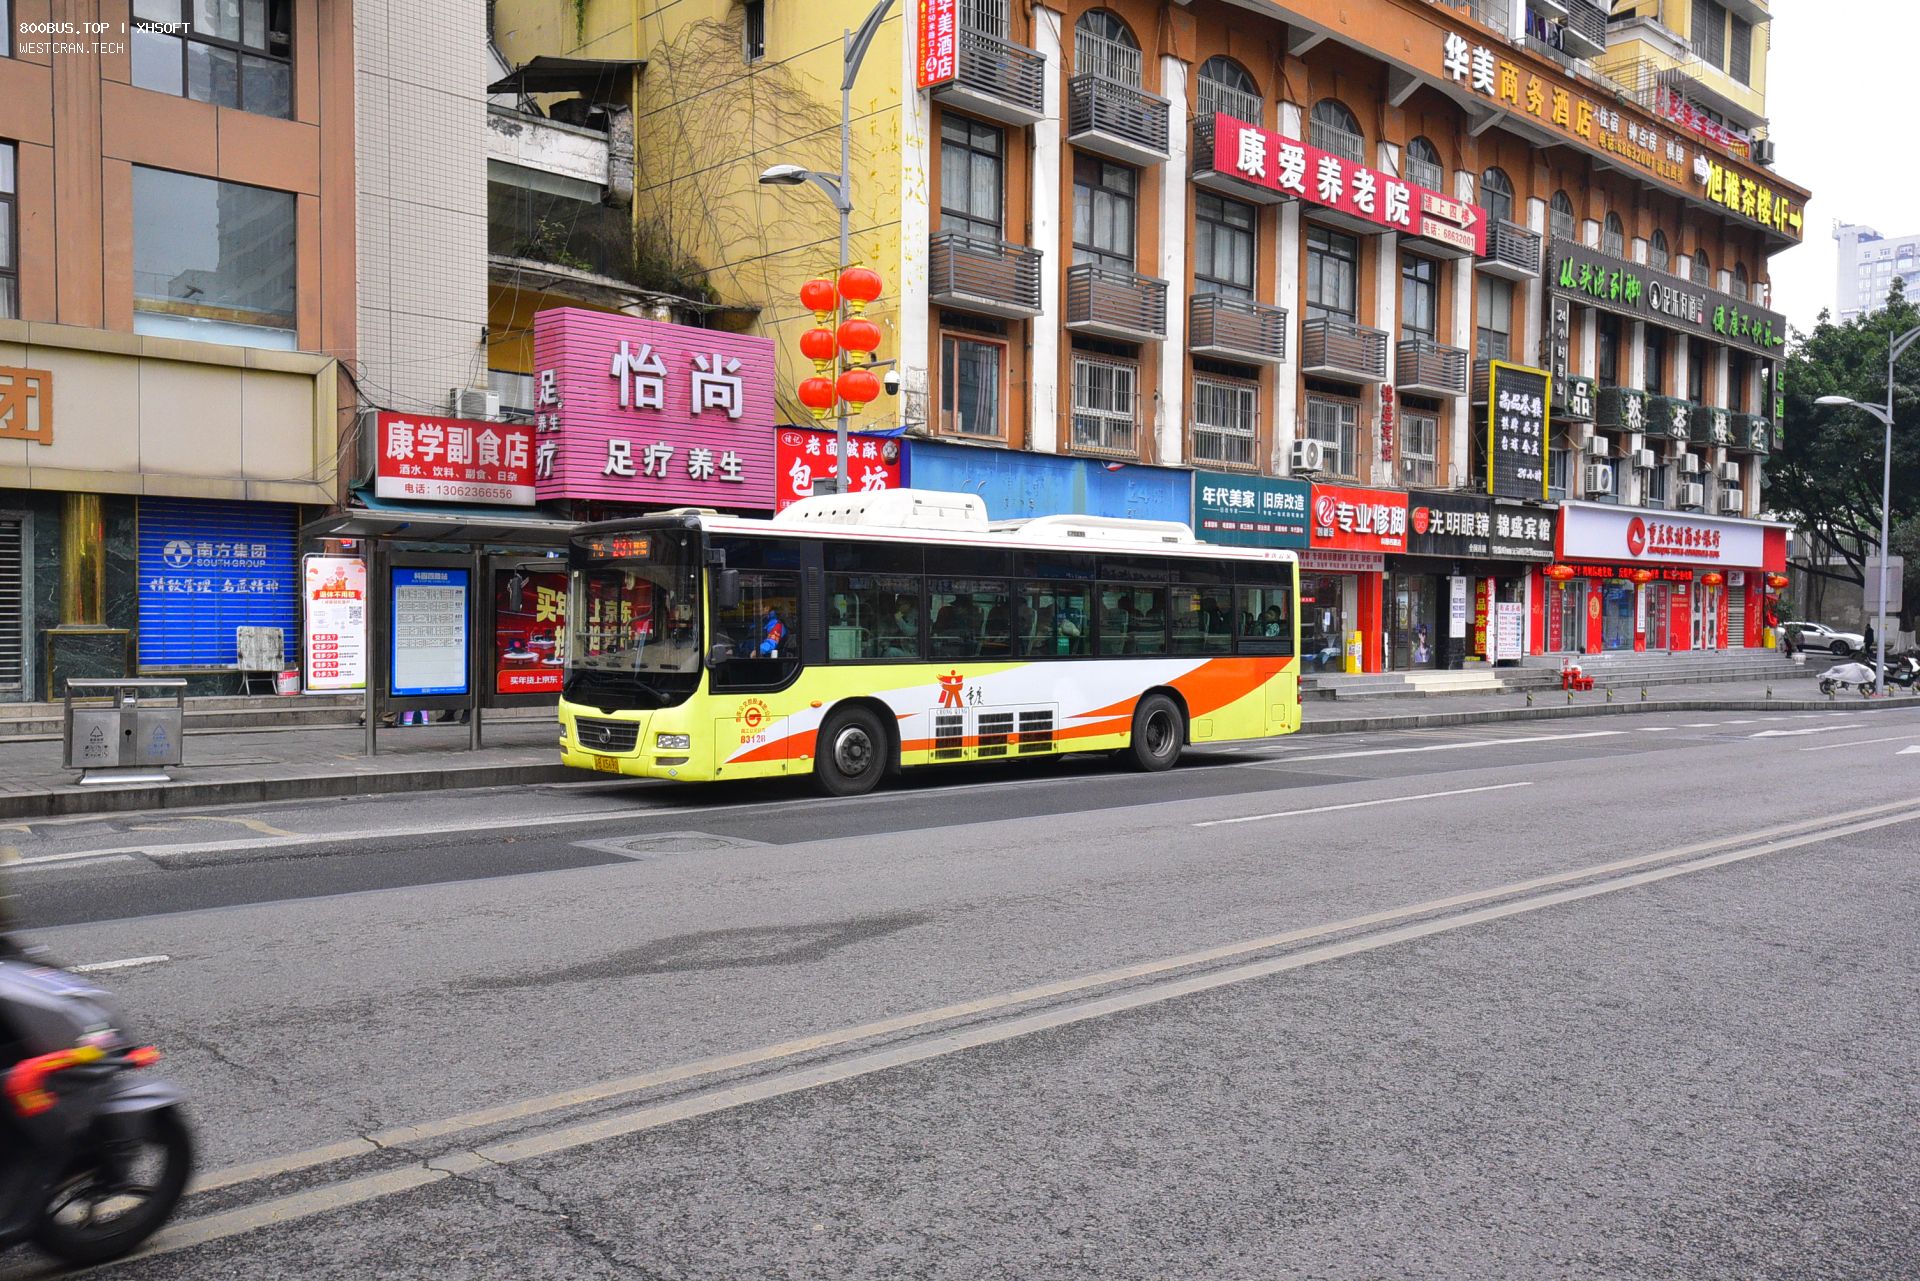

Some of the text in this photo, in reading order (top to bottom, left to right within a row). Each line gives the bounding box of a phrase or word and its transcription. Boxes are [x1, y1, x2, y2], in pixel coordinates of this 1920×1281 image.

[1444, 31, 1495, 96] 华美
[1499, 60, 1593, 139] 商务酒店
[1237, 127, 1410, 226] 康爱养老院
[1423, 194, 1471, 226] 请上四楼
[610, 340, 742, 419] 怡尚
[386, 420, 529, 469] 康学副食店
[602, 439, 745, 481] 足疗 养生
[399, 464, 518, 482] 酒水、饮料、副食、日杂
[1202, 486, 1304, 511] 年代美家 旧房改造
[1336, 501, 1406, 536] 专业修脚
[1429, 509, 1490, 538] 光明眼镜
[1496, 514, 1551, 541] 锦盛宾馆
[196, 542, 267, 559] 南方集团
[196, 559, 266, 568] SOUTH GROUP
